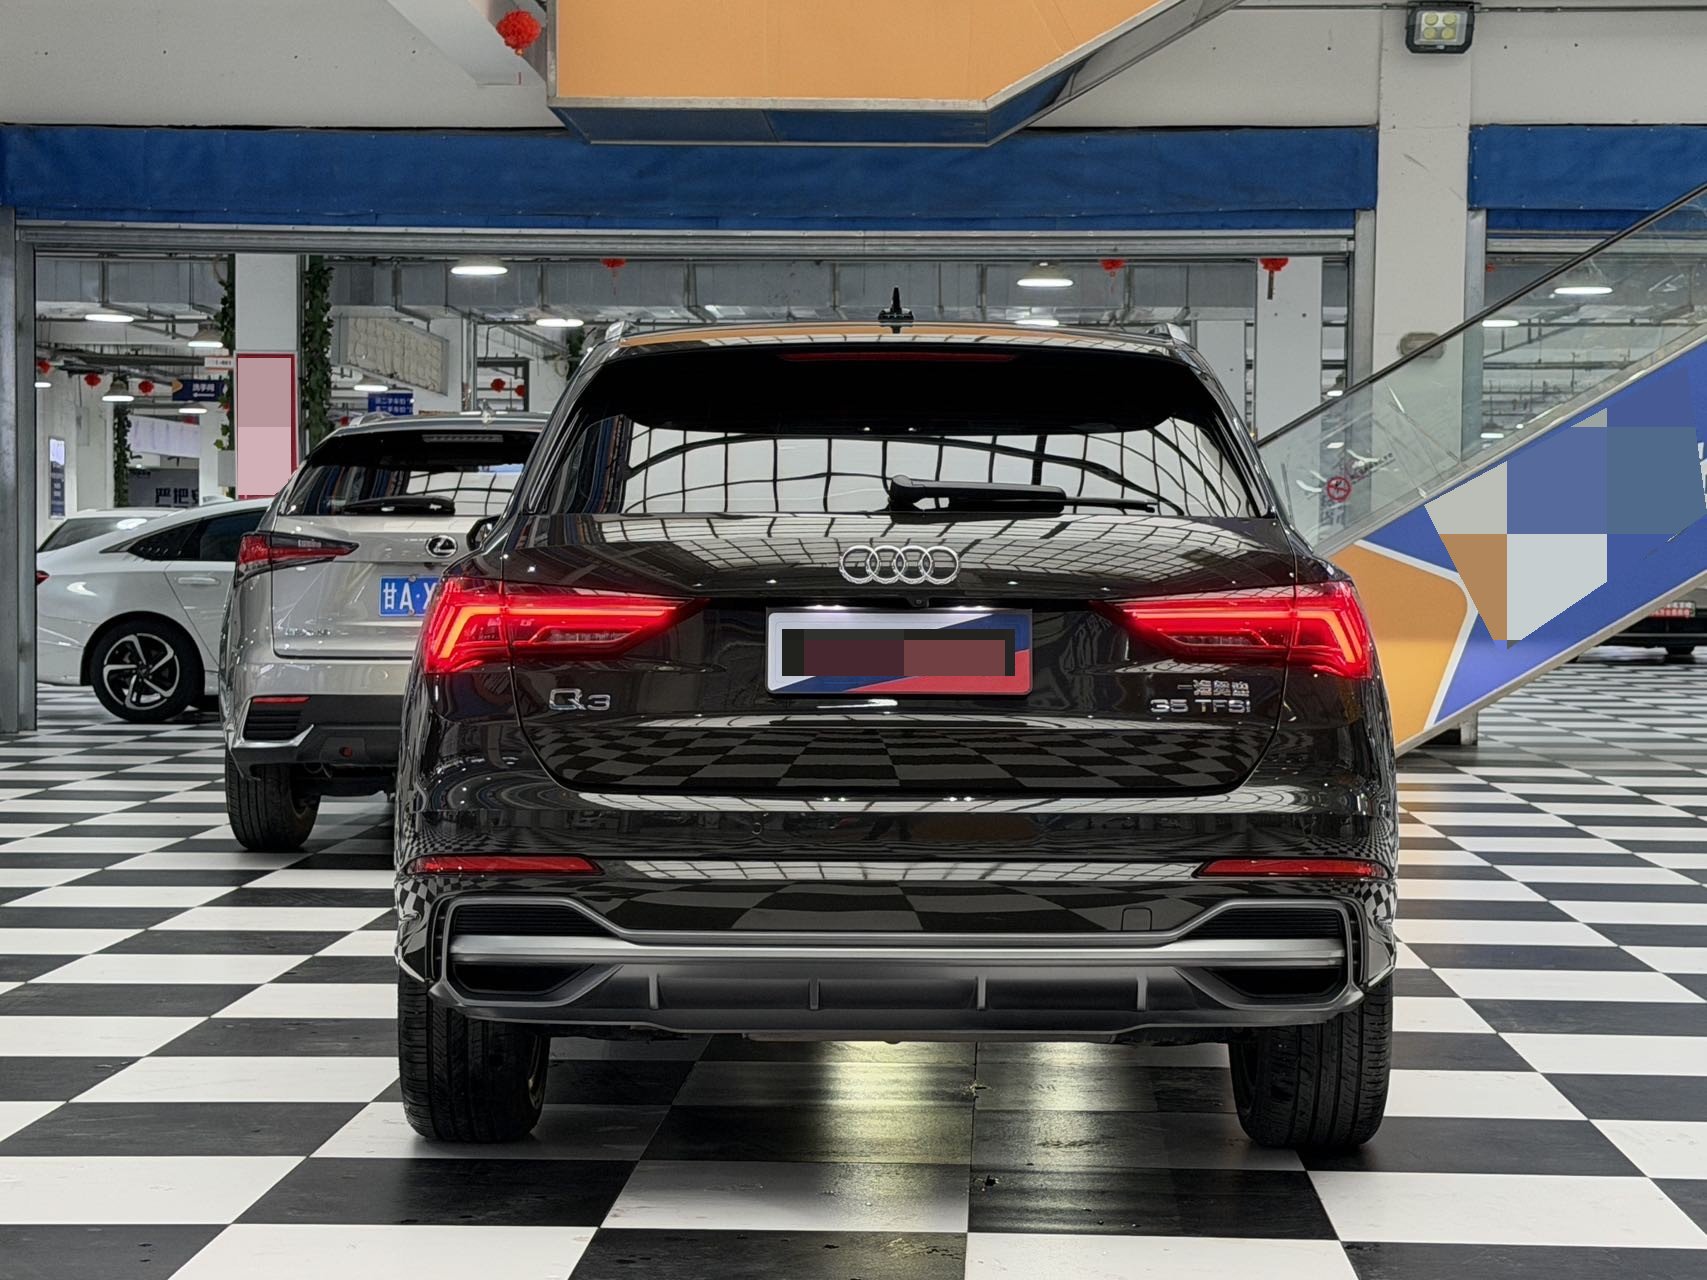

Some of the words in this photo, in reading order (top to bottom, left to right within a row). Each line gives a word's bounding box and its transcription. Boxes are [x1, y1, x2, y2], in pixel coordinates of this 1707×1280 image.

[1177, 679, 1250, 697] 一汽奥迪
[549, 687, 611, 711] Q3
[1150, 698, 1189, 713] 35
